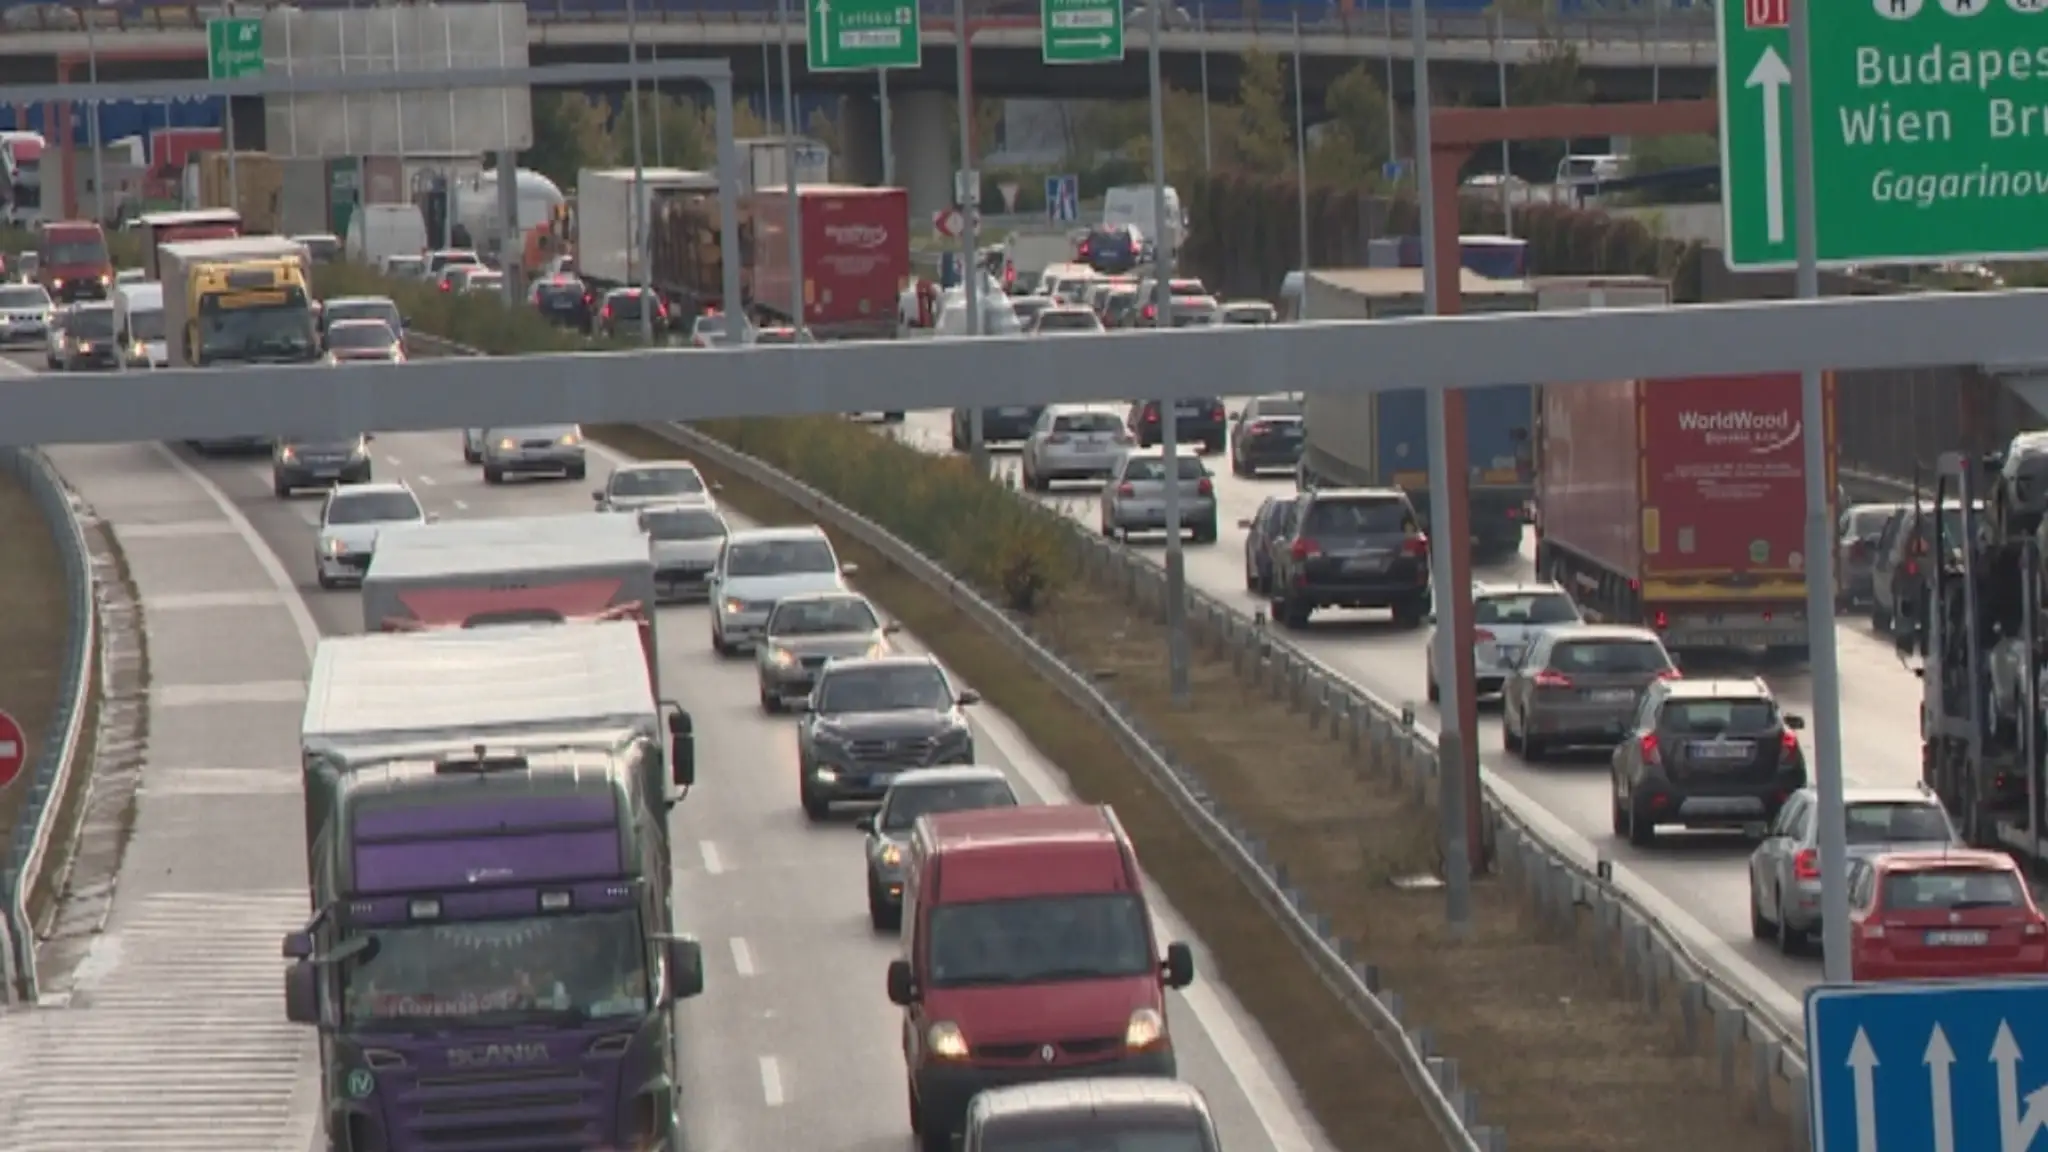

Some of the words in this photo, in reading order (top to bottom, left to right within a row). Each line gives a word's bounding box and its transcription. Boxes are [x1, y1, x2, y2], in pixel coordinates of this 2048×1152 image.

[1855, 42, 2048, 91] Budapes
[1839, 101, 1951, 146] Wien
[1989, 98, 2048, 139] Br
[1871, 162, 2048, 208] Gagarinov
[1678, 408, 1789, 431] WorldWood
